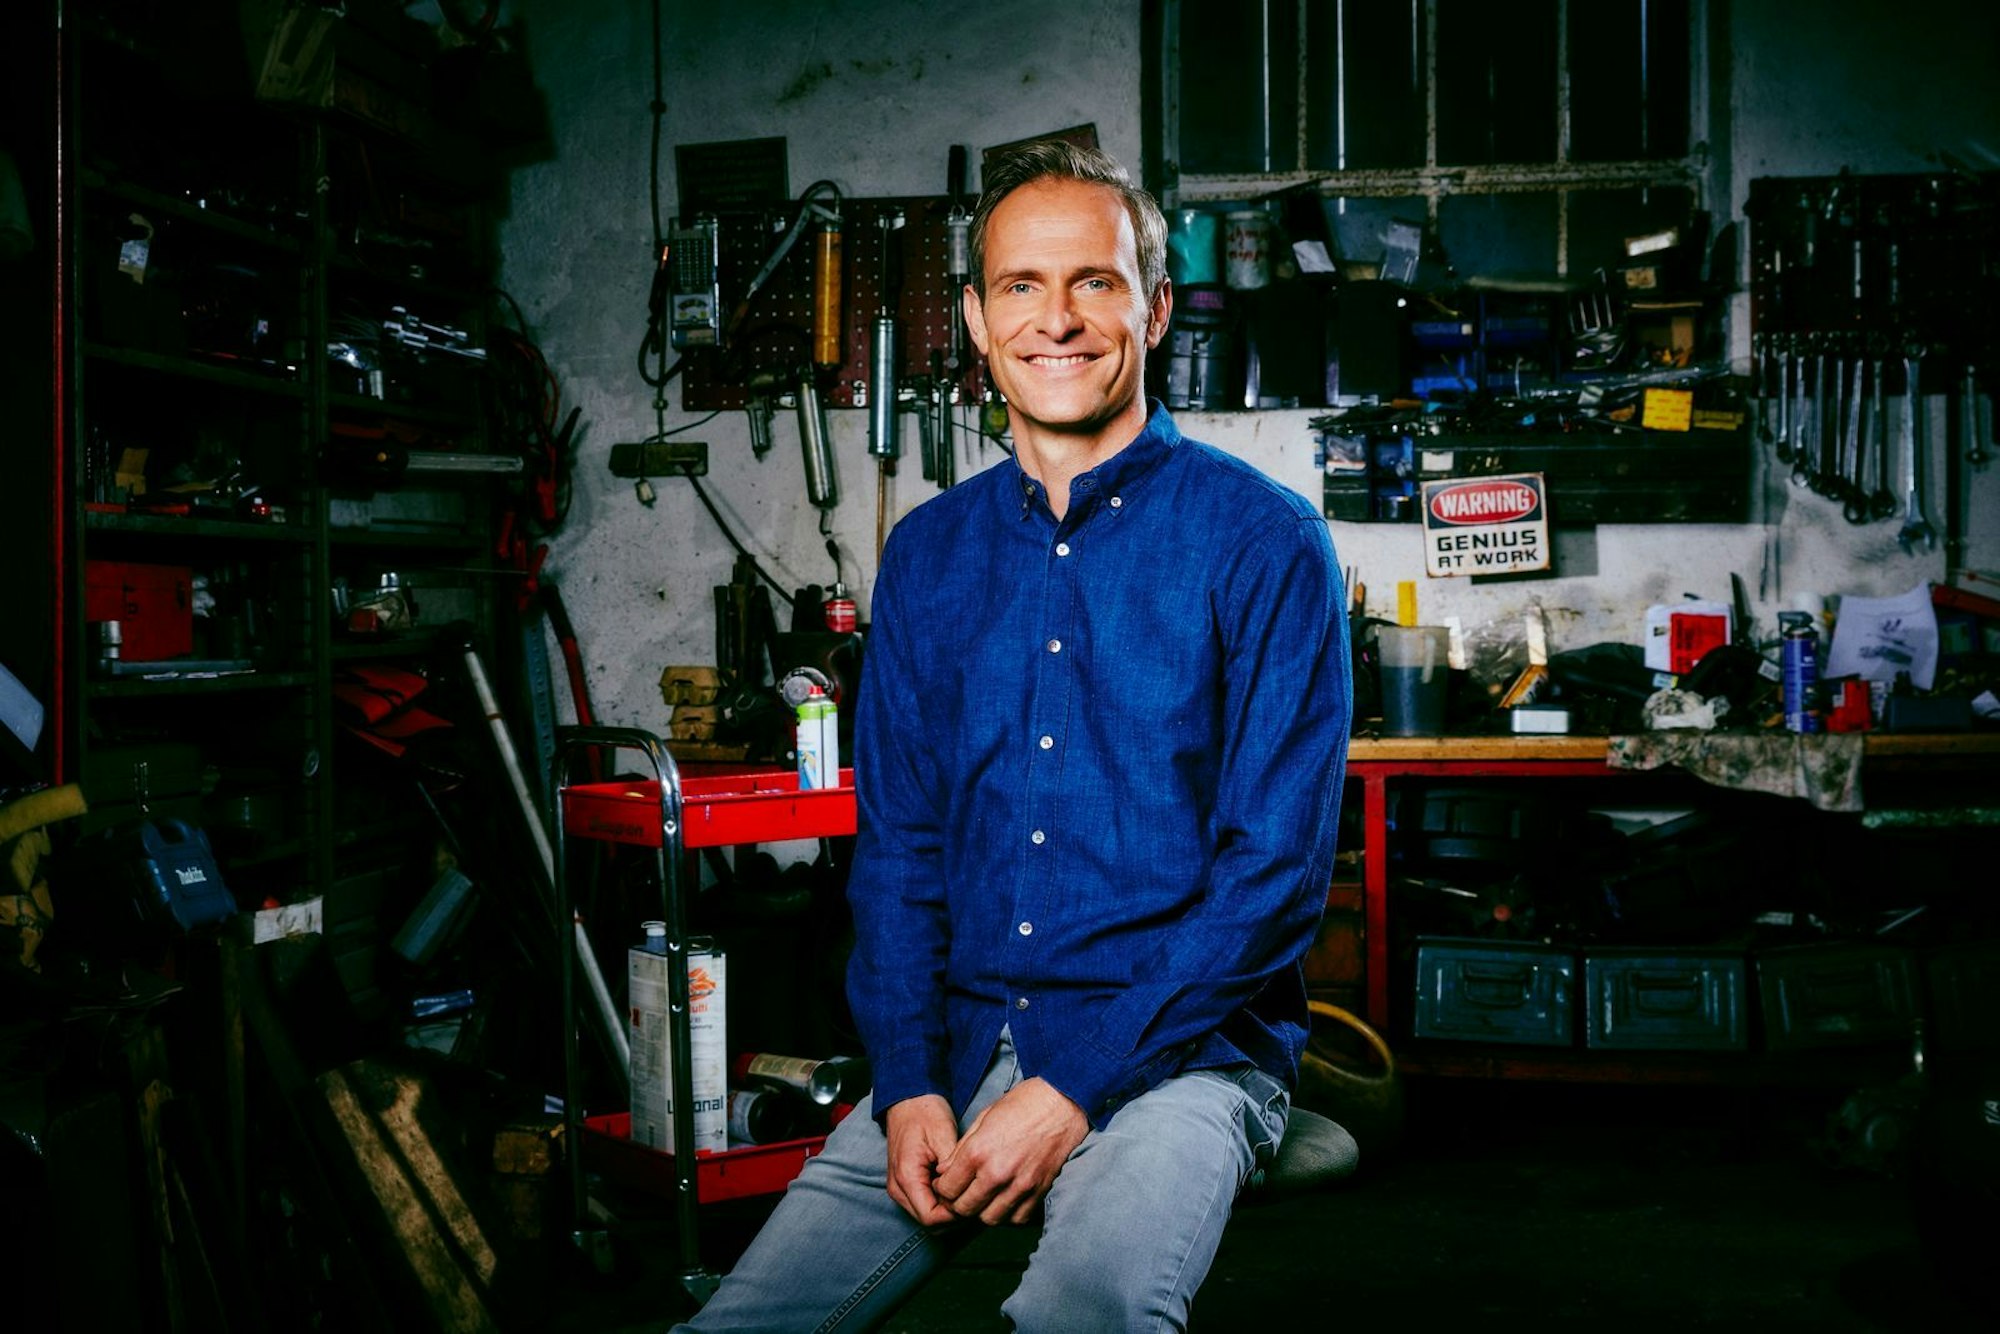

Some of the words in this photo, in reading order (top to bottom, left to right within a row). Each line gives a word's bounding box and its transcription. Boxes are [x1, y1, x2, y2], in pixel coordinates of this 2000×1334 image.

[1439, 488, 1531, 518] WARNING
[1437, 529, 1537, 552] GENIUS
[1438, 555, 1464, 568] AT
[1474, 548, 1538, 565] WORK
